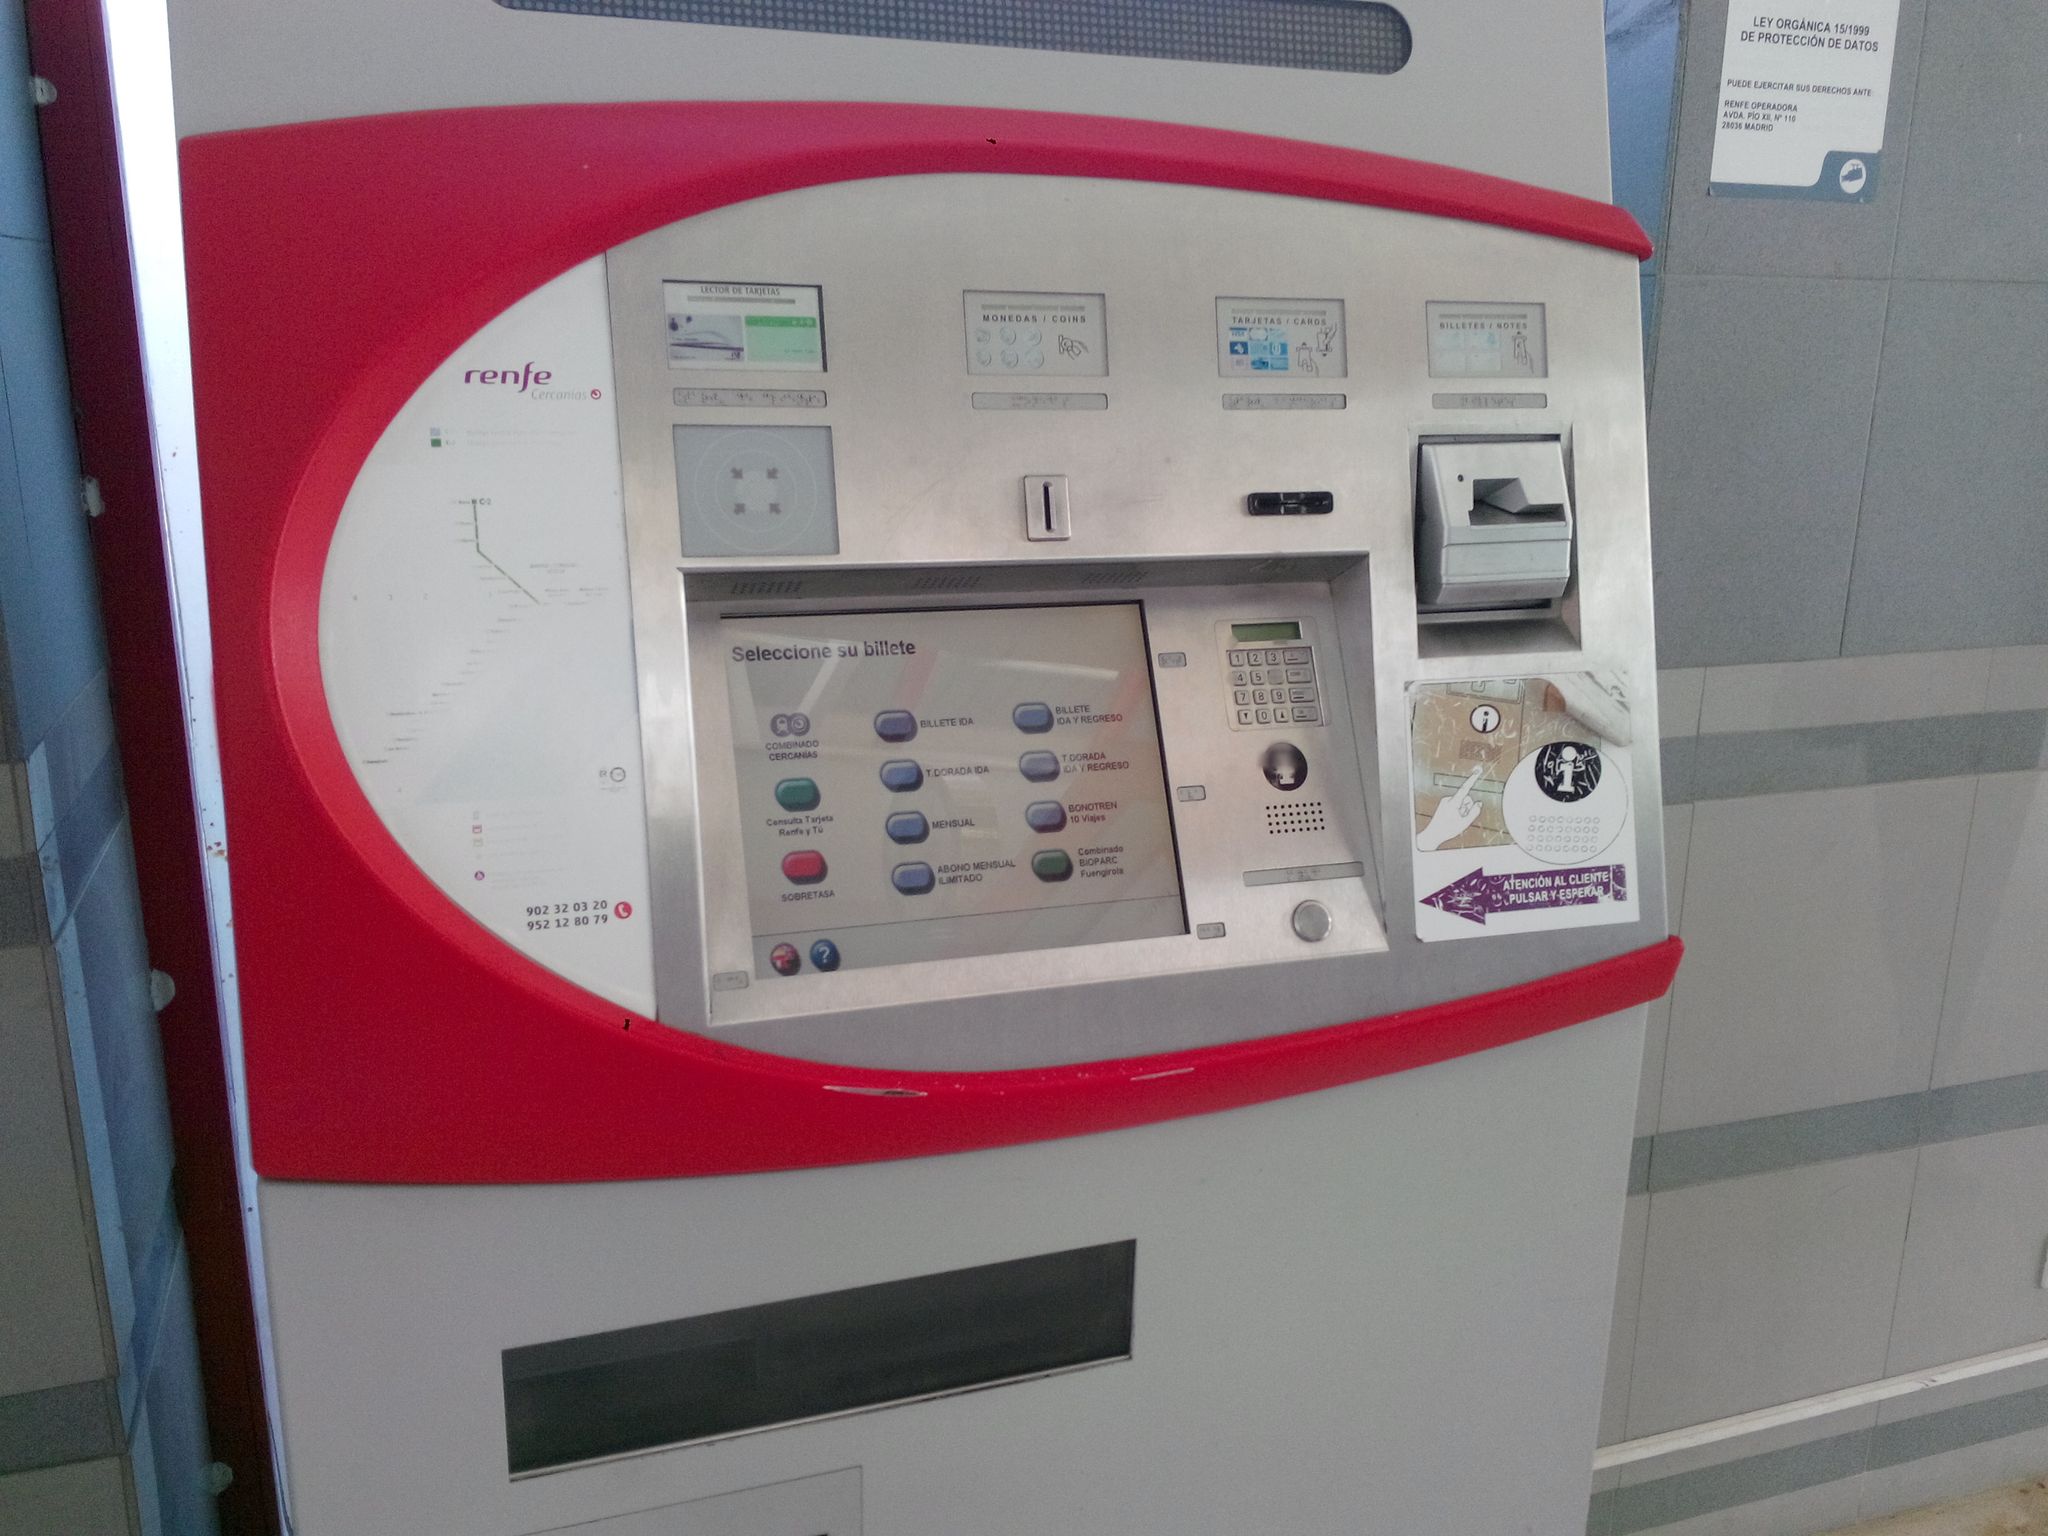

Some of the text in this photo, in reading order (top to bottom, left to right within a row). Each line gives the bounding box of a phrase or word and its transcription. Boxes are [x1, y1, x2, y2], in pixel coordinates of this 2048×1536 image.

[1753, 16, 1870, 36] LEY ORGÁNICA 15/1999
[1740, 30, 1879, 52] DE PROTECCIÓN DE DATOS
[1727, 78, 1872, 97] PUEDE EJERCITAR SUS DERECHOS ANTE
[1724, 100, 1798, 112] RENFE OPERADORA
[1744, 122, 1774, 132] MADRID
[700, 285, 781, 296] LECTOR DE TARJETAS
[982, 314, 1038, 323] MONEDAS
[1052, 315, 1086, 323] COINS
[1232, 316, 1282, 325] TARJETAS
[464, 361, 552, 393] renfe
[732, 640, 916, 662] Seleccione su billete
[1252, 653, 1258, 662] 2
[1271, 653, 1277, 662] 3
[1237, 672, 1261, 682] 4 5
[1240, 692, 1246, 701] 7
[1258, 692, 1264, 700] 8
[1276, 691, 1282, 700] 9
[1055, 705, 1090, 714] BILLETE
[920, 717, 974, 728] BILLETE IDA
[1056, 716, 1071, 725] IDA
[1080, 713, 1123, 723] REGRESO
[765, 740, 819, 751] COMBINADO
[925, 766, 990, 777] T.DORADA IDA
[1086, 761, 1129, 772] REGRESO
[1068, 801, 1117, 813] BONOTREN
[766, 815, 834, 826] Consulta Tarjeta
[932, 818, 975, 829] MENSUAL
[1070, 814, 1106, 823] 10 Viajes
[779, 827, 804, 837] Renfe
[1078, 845, 1124, 856] Combinado
[937, 860, 1016, 874] ABONO MENSUAL
[1079, 856, 1118, 867] BIOPARC
[1080, 867, 1124, 879] Fuengirola
[1502, 871, 1609, 891] ATENCIÓN AL CLIENTE
[781, 889, 835, 902] SOBRETASA
[1508, 885, 1604, 905] PULSAR Y ESPERAR
[526, 899, 608, 917] 902 32 03 20
[527, 913, 608, 932] 952 12 80 79
